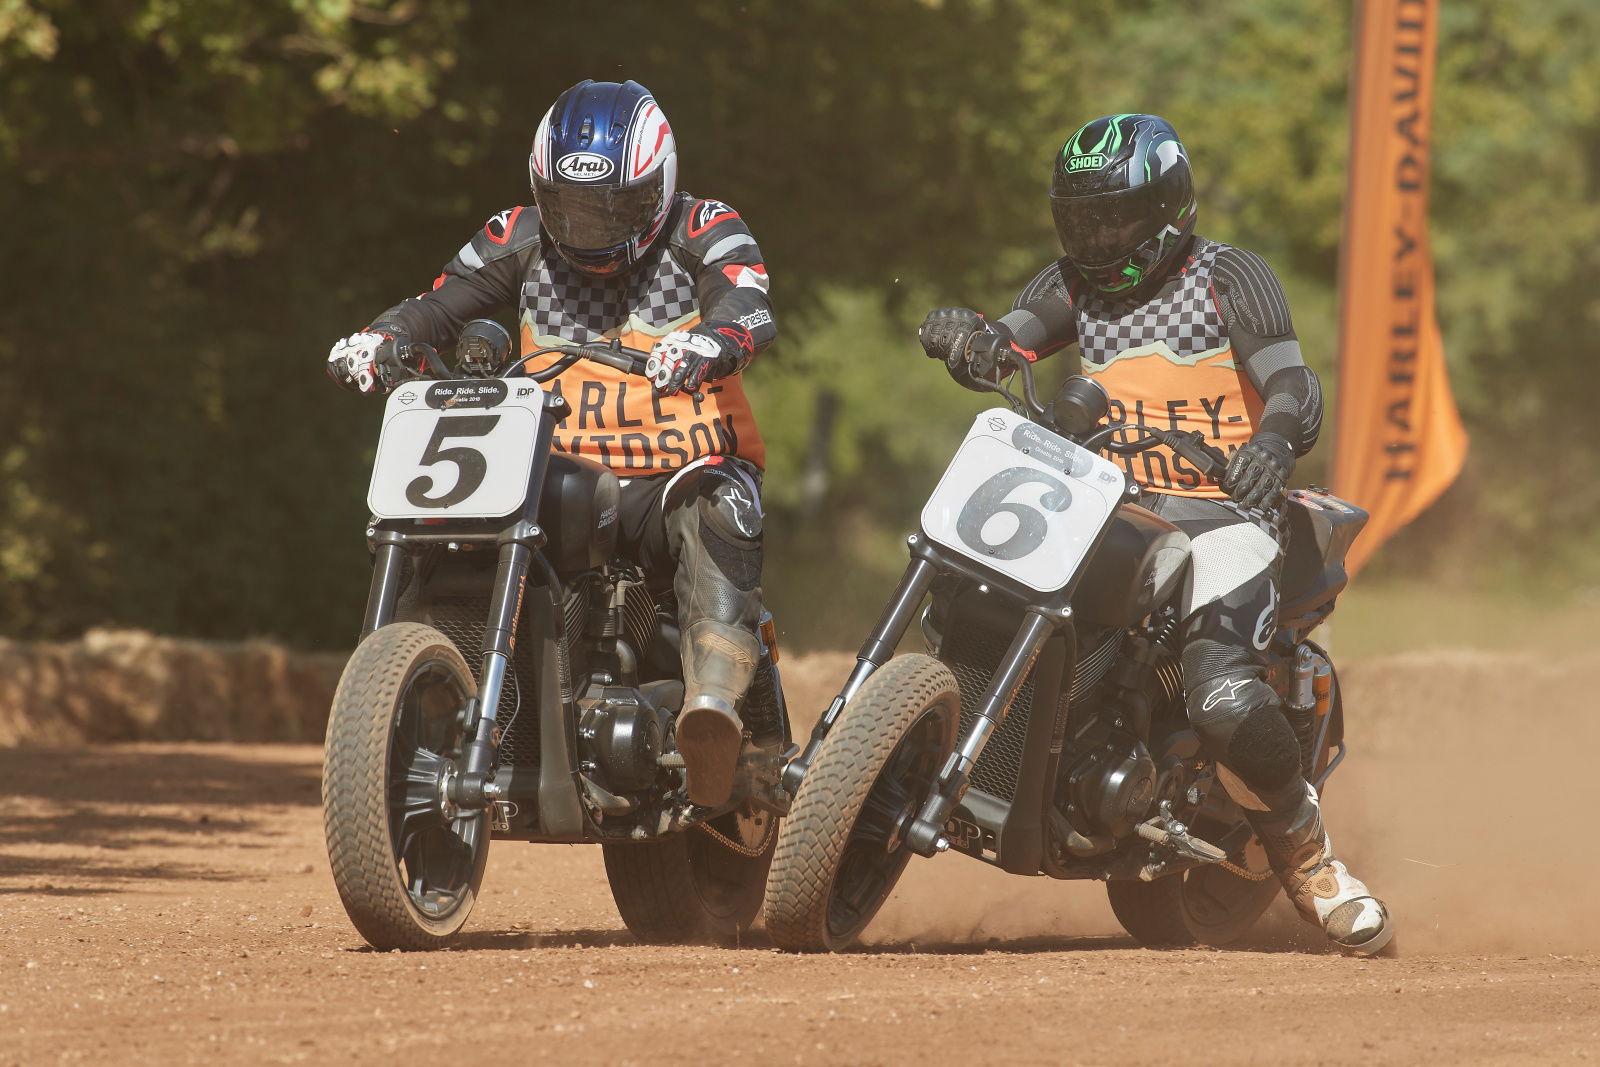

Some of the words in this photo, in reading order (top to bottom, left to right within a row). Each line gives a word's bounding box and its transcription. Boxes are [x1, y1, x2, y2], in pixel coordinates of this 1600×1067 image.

[561, 157, 605, 172] Arai
[1069, 156, 1103, 170] SHOEI
[434, 388, 454, 396] Ride.
[456, 387, 476, 395] Ride.
[478, 386, 500, 394] Slide.
[516, 388, 535, 396] iDP
[405, 414, 502, 509] 5
[956, 466, 1072, 560] 6
